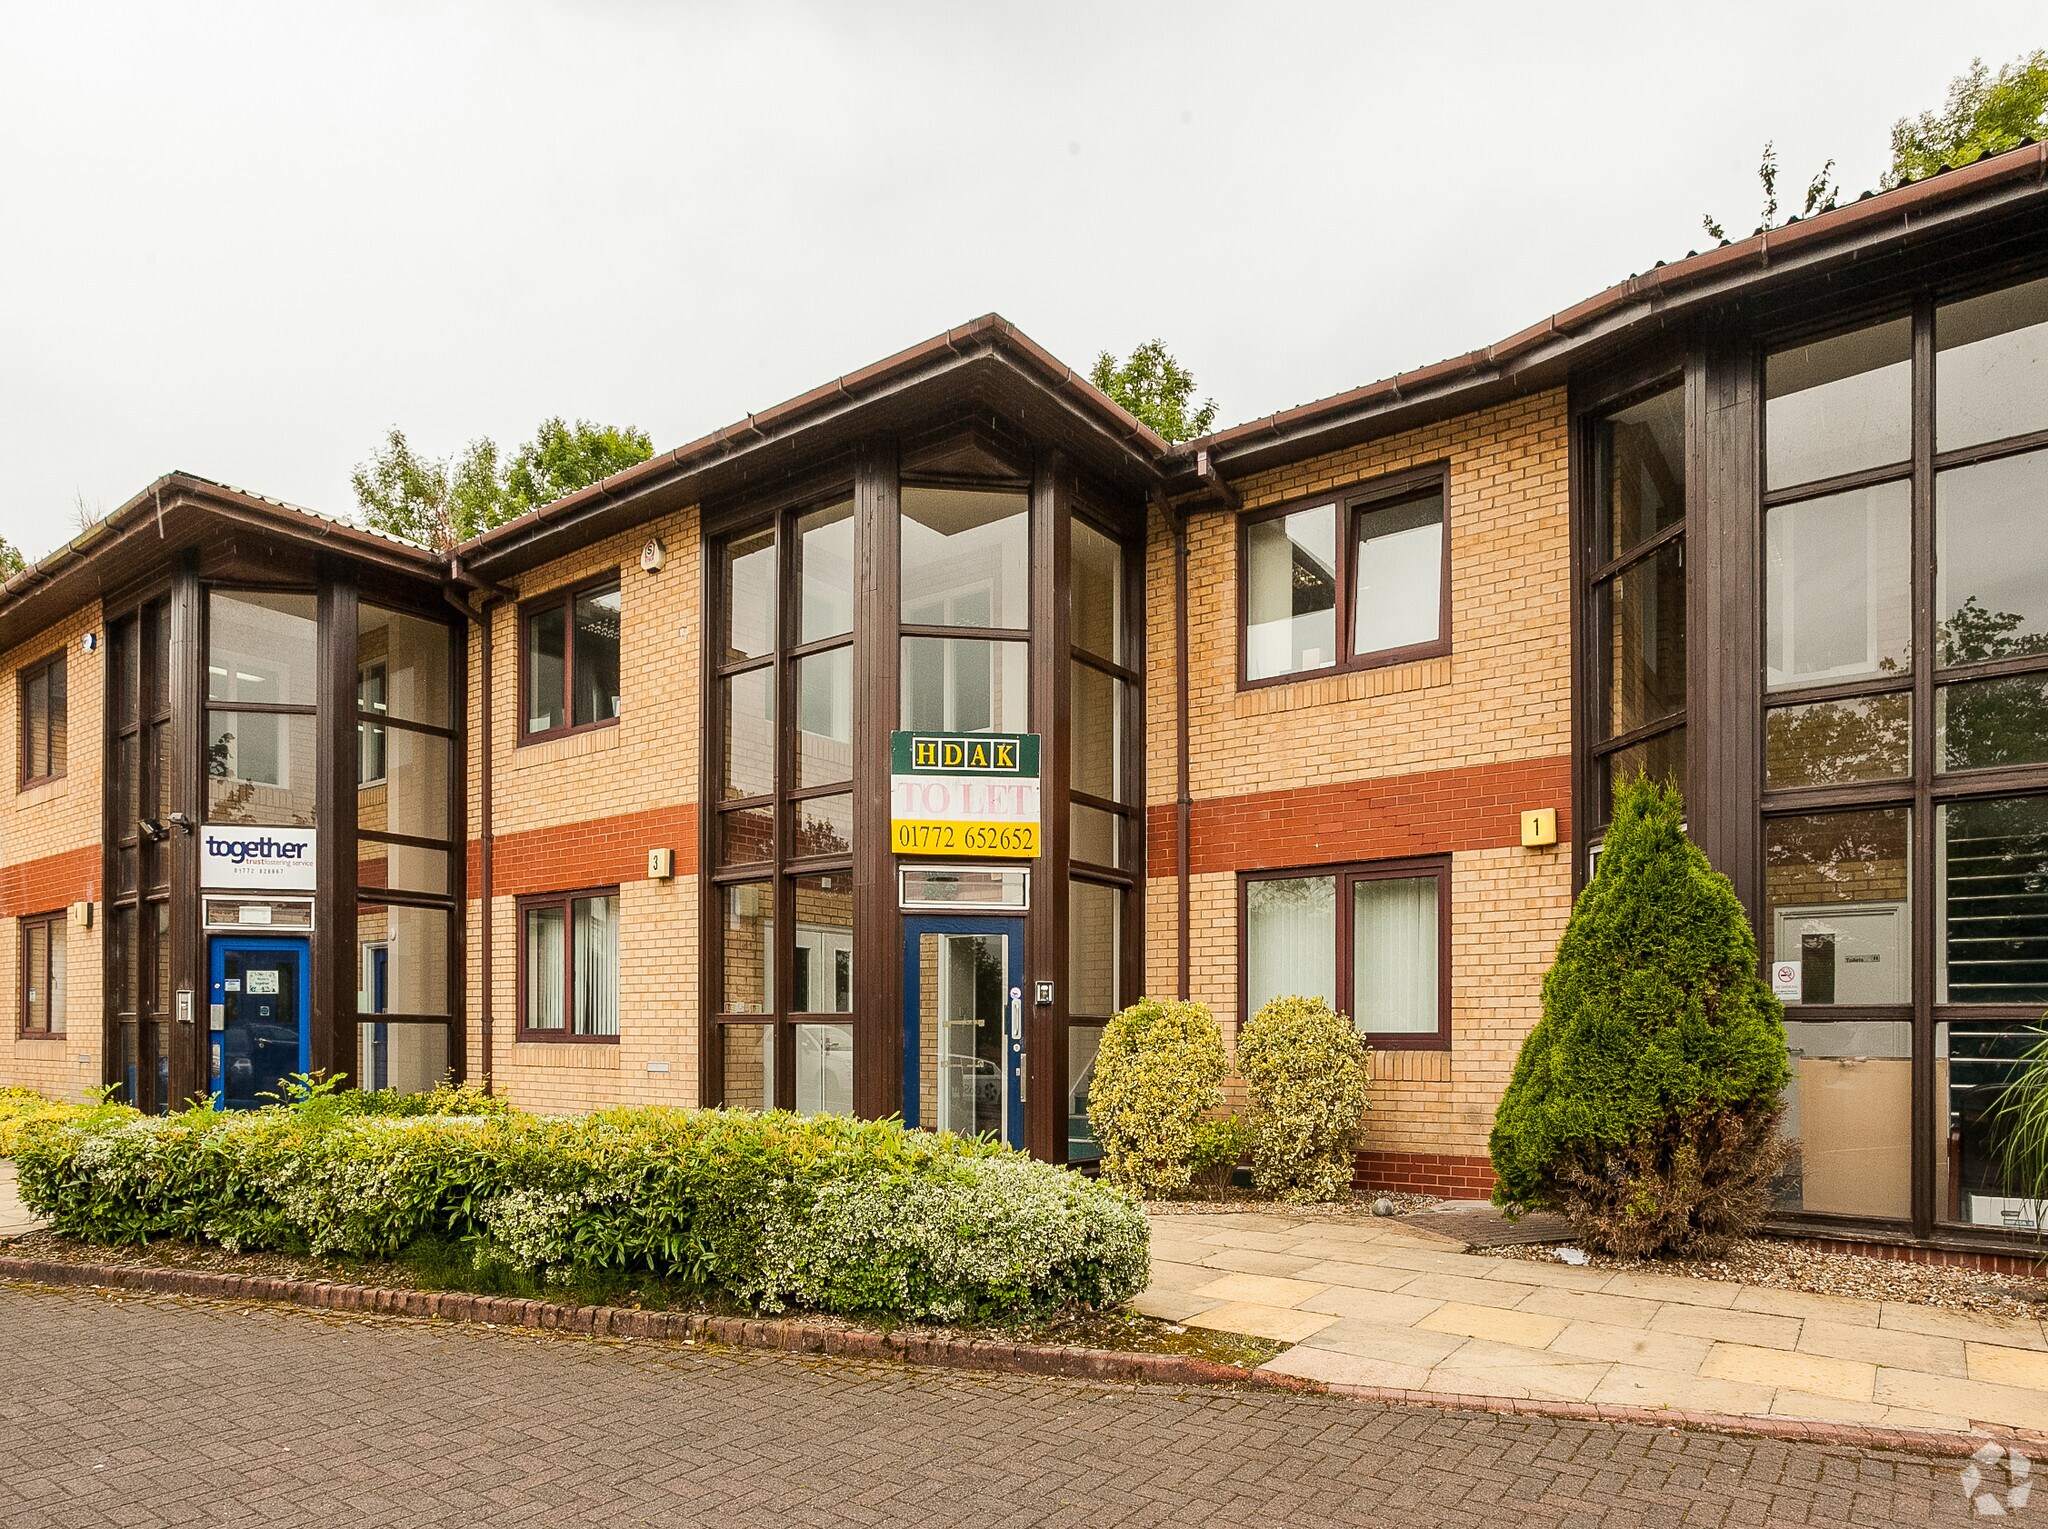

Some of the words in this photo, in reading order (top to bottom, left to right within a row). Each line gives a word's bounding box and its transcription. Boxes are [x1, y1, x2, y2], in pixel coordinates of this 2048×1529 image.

[917, 743, 1014, 767] HDAK
[898, 783, 950, 814] TO
[961, 783, 1033, 815] LET
[899, 825, 955, 848] 01772
[965, 827, 1033, 850] 652652
[1533, 818, 1539, 836] 1
[207, 836, 308, 864] together
[653, 855, 658, 870] 3
